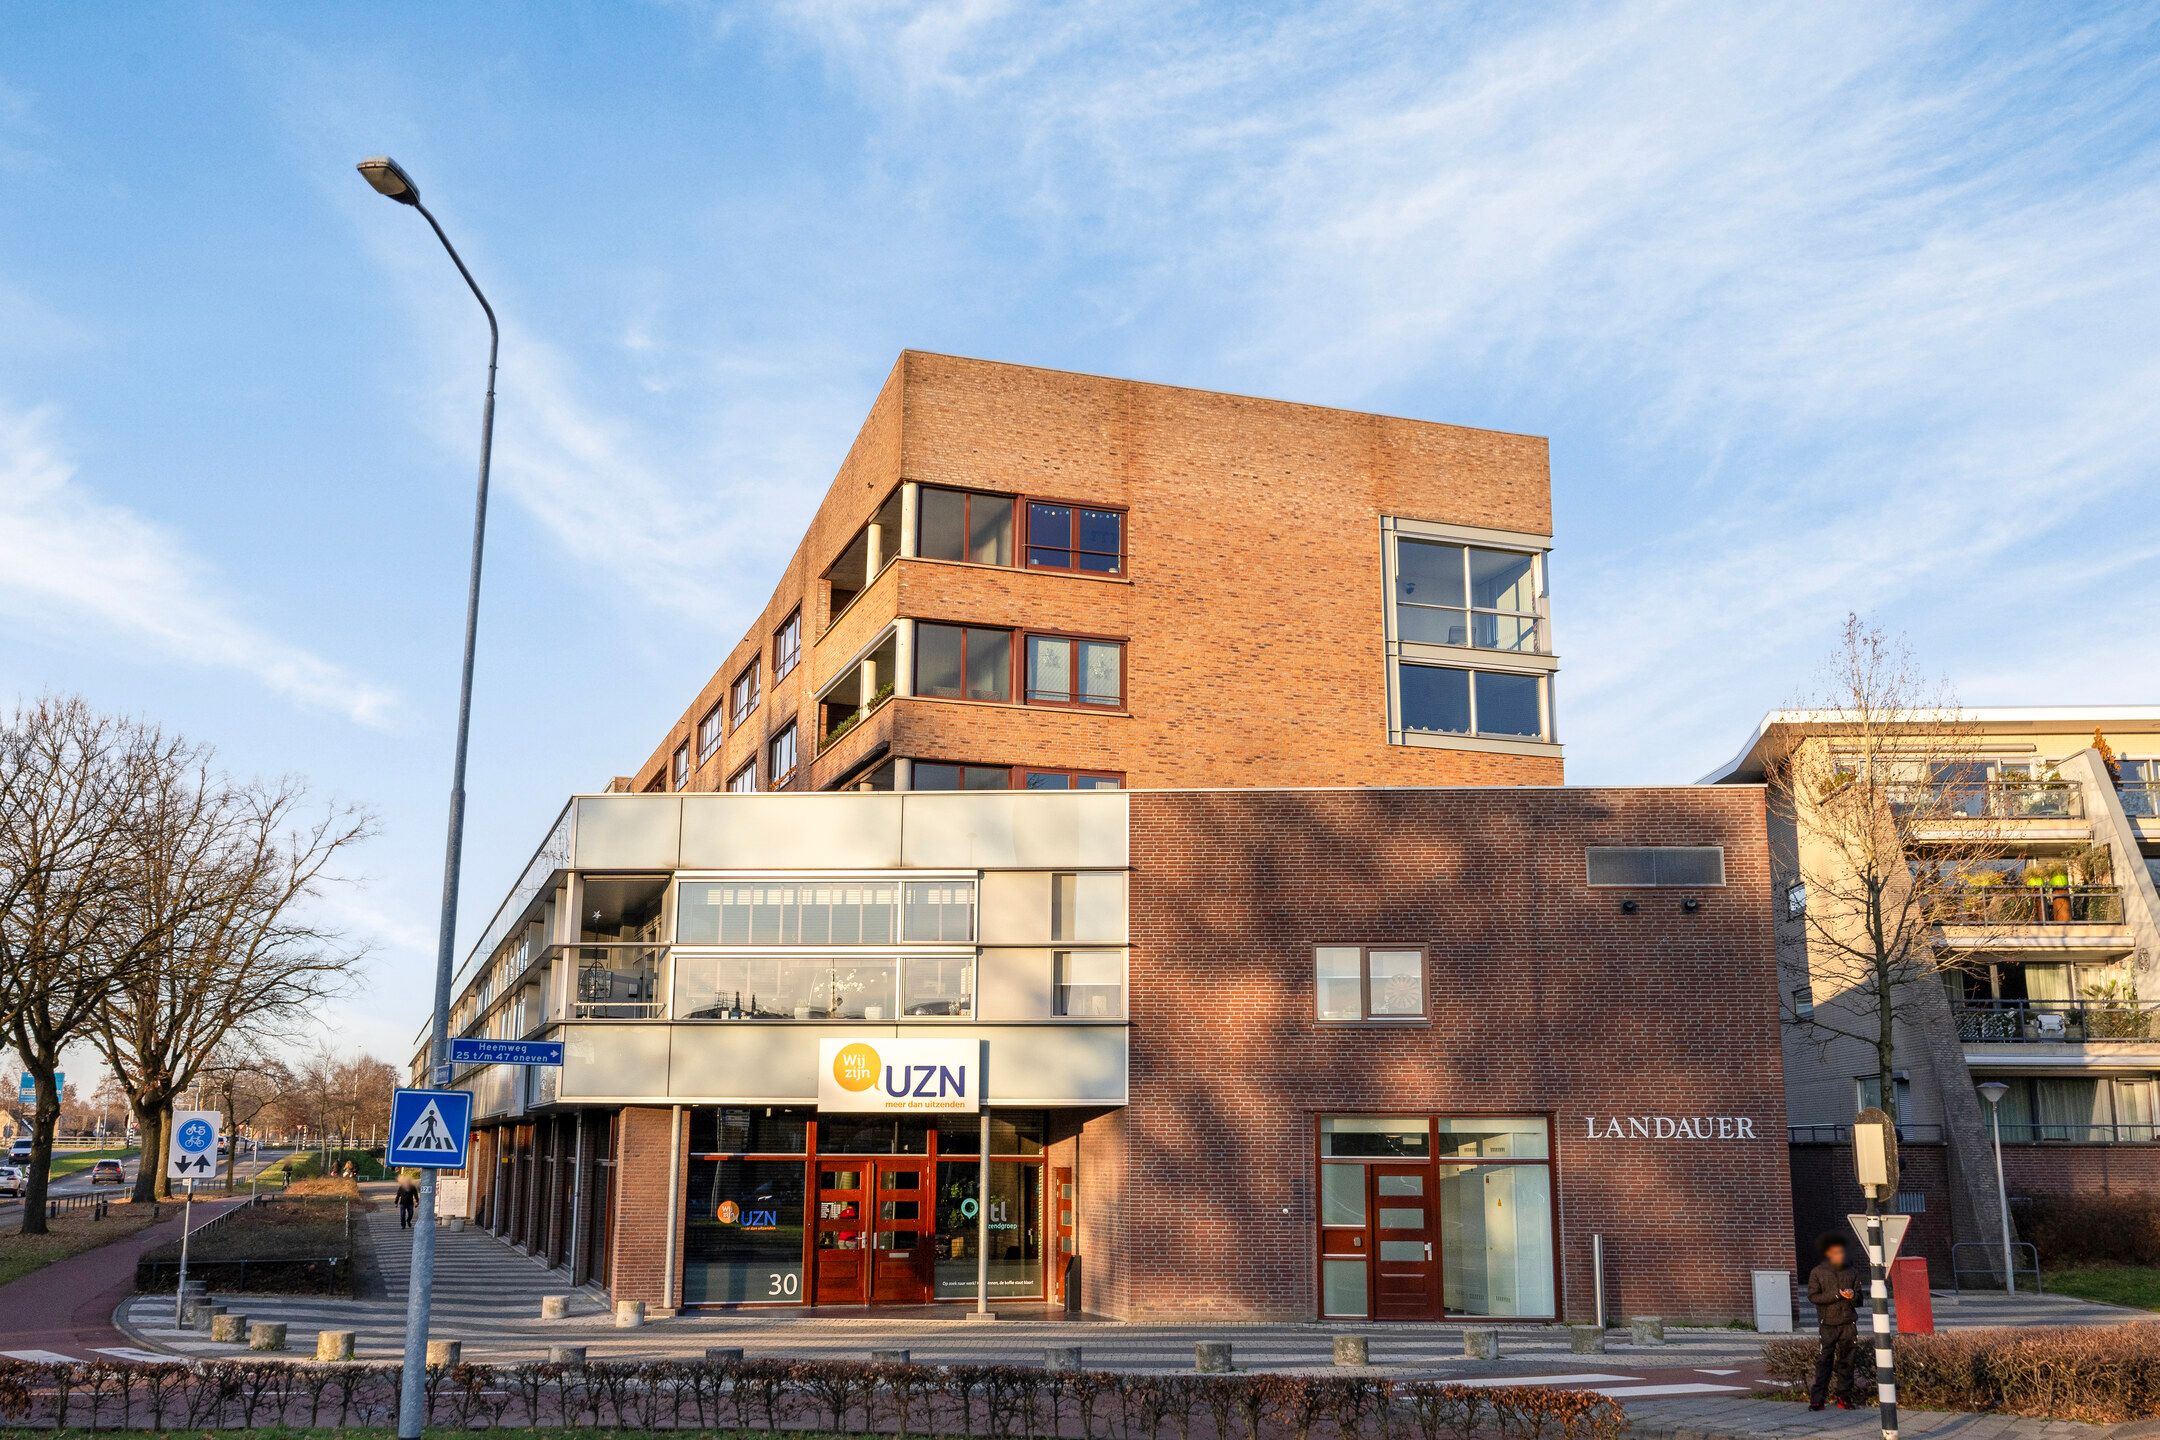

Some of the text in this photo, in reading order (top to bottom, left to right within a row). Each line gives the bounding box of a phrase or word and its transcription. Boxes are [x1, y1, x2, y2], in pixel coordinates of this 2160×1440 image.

[479, 1043, 527, 1054] Heemweg
[456, 1051, 470, 1060] 25
[473, 1052, 493, 1060] t/m
[496, 1053, 510, 1061] 47
[842, 1054, 865, 1068] Wij
[845, 1067, 871, 1081] zijn
[886, 1065, 966, 1098] UZN
[907, 1100, 923, 1108] dan
[925, 1100, 965, 1108] uitzenden
[1585, 1116, 1757, 1139] LANDAUER
[741, 1210, 777, 1226] UZN
[768, 1273, 798, 1296] 30
